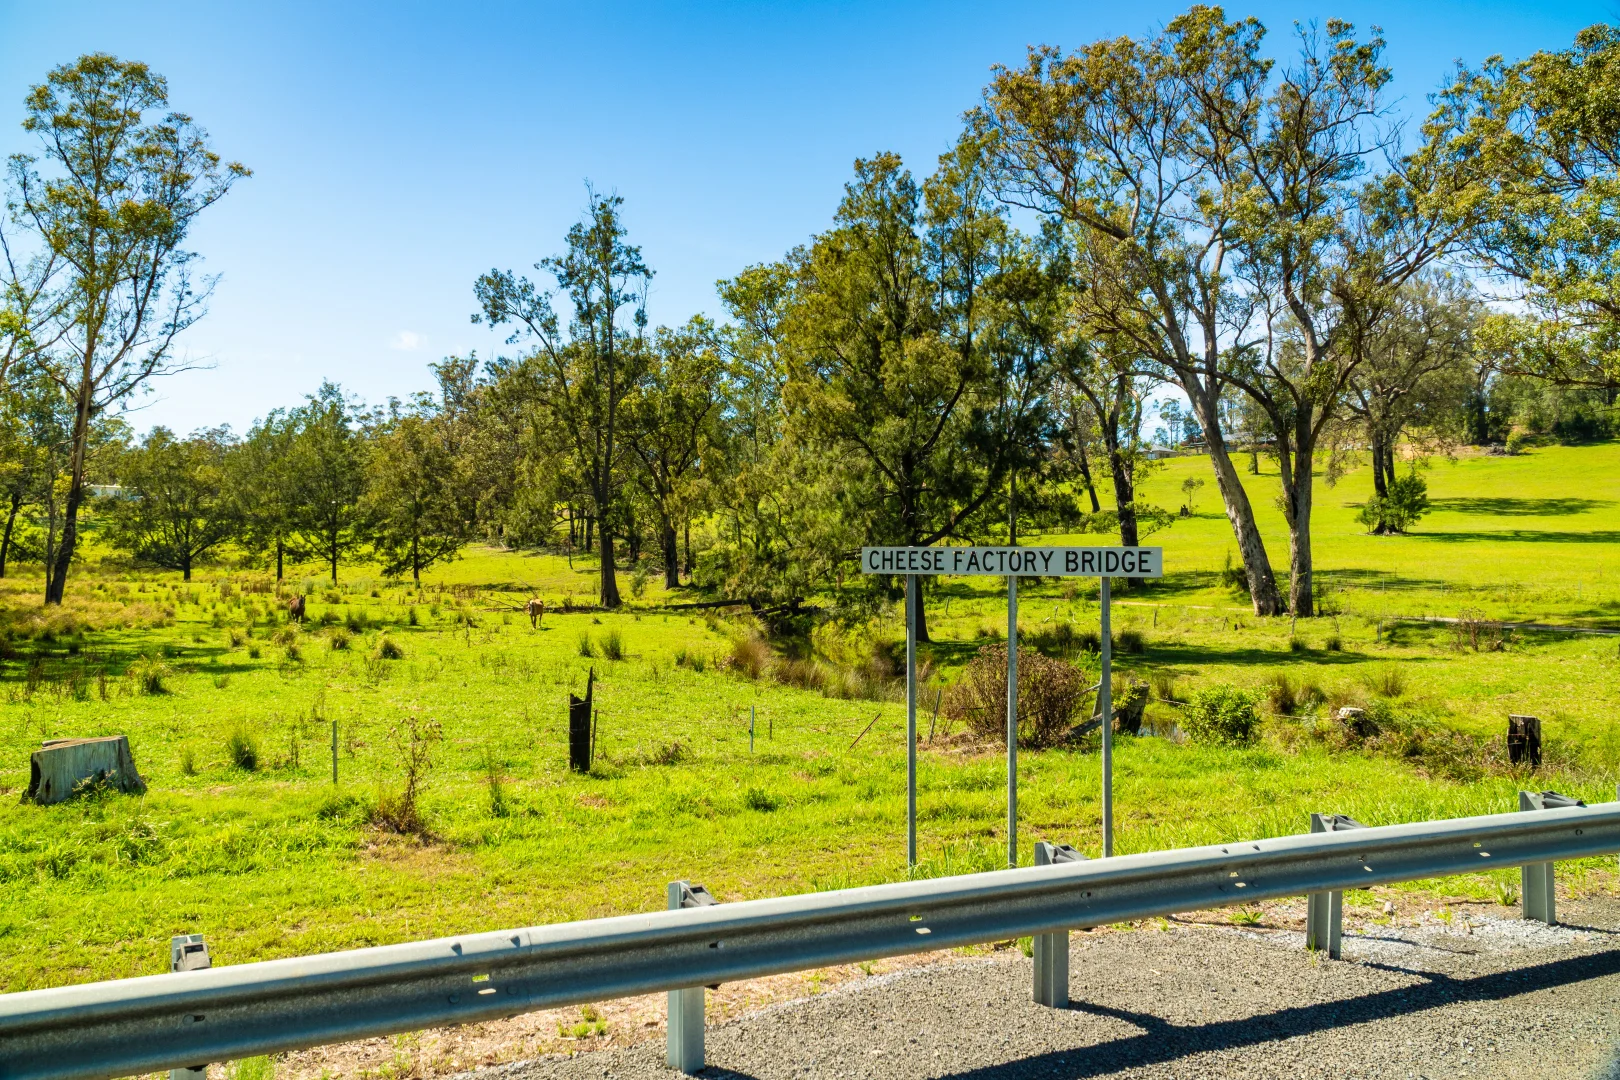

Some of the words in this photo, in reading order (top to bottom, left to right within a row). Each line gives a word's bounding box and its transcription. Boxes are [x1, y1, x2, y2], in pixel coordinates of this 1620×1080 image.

[869, 550, 945, 571] CHEESE
[953, 550, 1055, 572] FACTORY
[1065, 550, 1152, 573] BRIDGE
